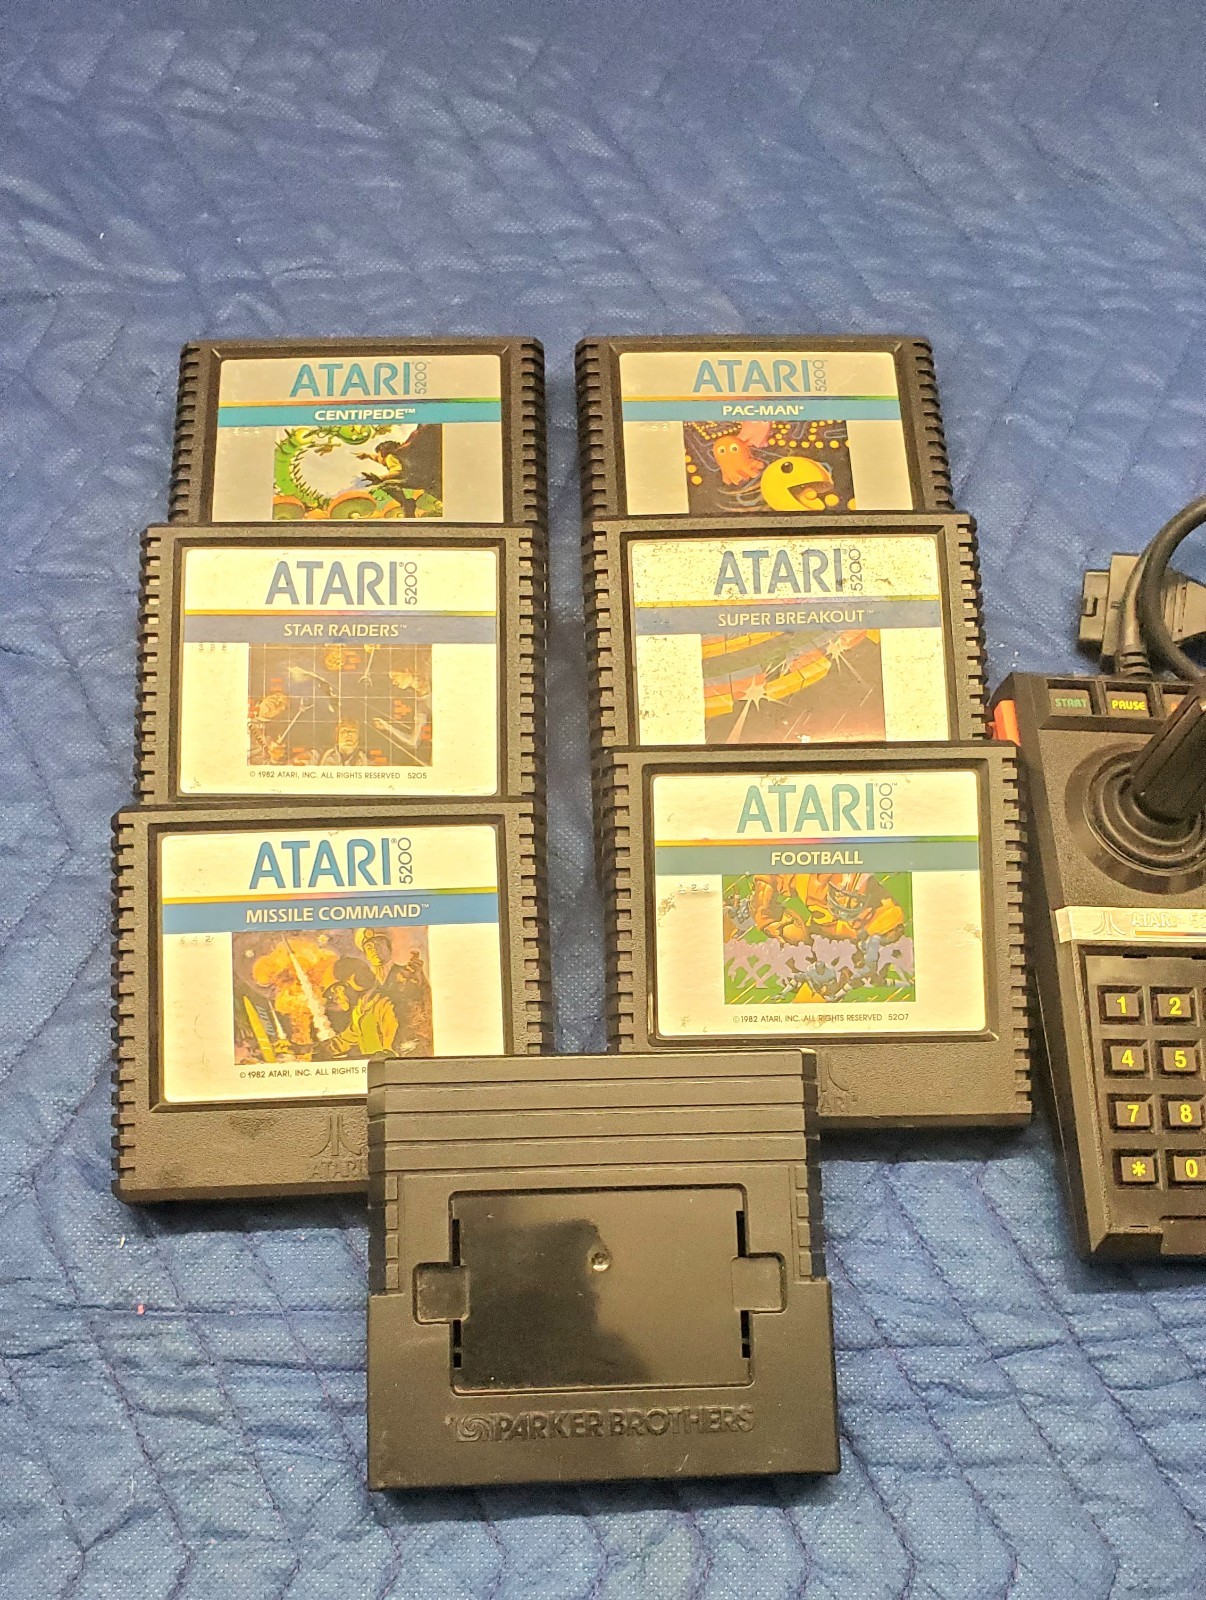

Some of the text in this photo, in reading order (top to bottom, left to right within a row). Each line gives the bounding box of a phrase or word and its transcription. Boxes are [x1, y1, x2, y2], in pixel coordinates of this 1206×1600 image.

[289, 362, 411, 398] ATARI
[414, 361, 428, 395] 5200
[692, 359, 811, 393] ATARI
[813, 359, 828, 393] 5200
[714, 548, 844, 595] ATARI
[848, 548, 864, 592] 5200
[404, 561, 418, 606] 5200
[718, 612, 771, 627] SUPER
[284, 623, 324, 637] STAR
[1055, 698, 1087, 709] START
[1111, 699, 1146, 711] PAUSE
[258, 771, 275, 779] 1982
[302, 771, 319, 779] INC.
[321, 771, 334, 779] ALL
[364, 772, 401, 780] RESERVED
[407, 772, 428, 780] 5205
[737, 783, 875, 834] ATARI
[878, 782, 894, 831] 5200
[397, 837, 414, 885] 5200
[771, 850, 864, 867] FOOTBALL
[246, 907, 314, 924] MISSILE
[1116, 996, 1182, 1015] 1 2
[785, 1015, 801, 1023] INC.
[802, 1014, 816, 1022] ALL
[818, 1014, 845, 1022] RIGHTS
[846, 1014, 883, 1022] RESERVED
[888, 1013, 909, 1021] 5207
[1121, 1049, 1187, 1068] 4 5
[248, 1070, 266, 1079] 1982
[295, 1068, 312, 1077] INC.
[315, 1068, 329, 1076] ALL
[331, 1067, 360, 1075] RIGHTS
[1127, 1104, 1193, 1123] 7 8
[1185, 1159, 1198, 1178] 0
[491, 1403, 755, 1442] PARKER BROTHERS
